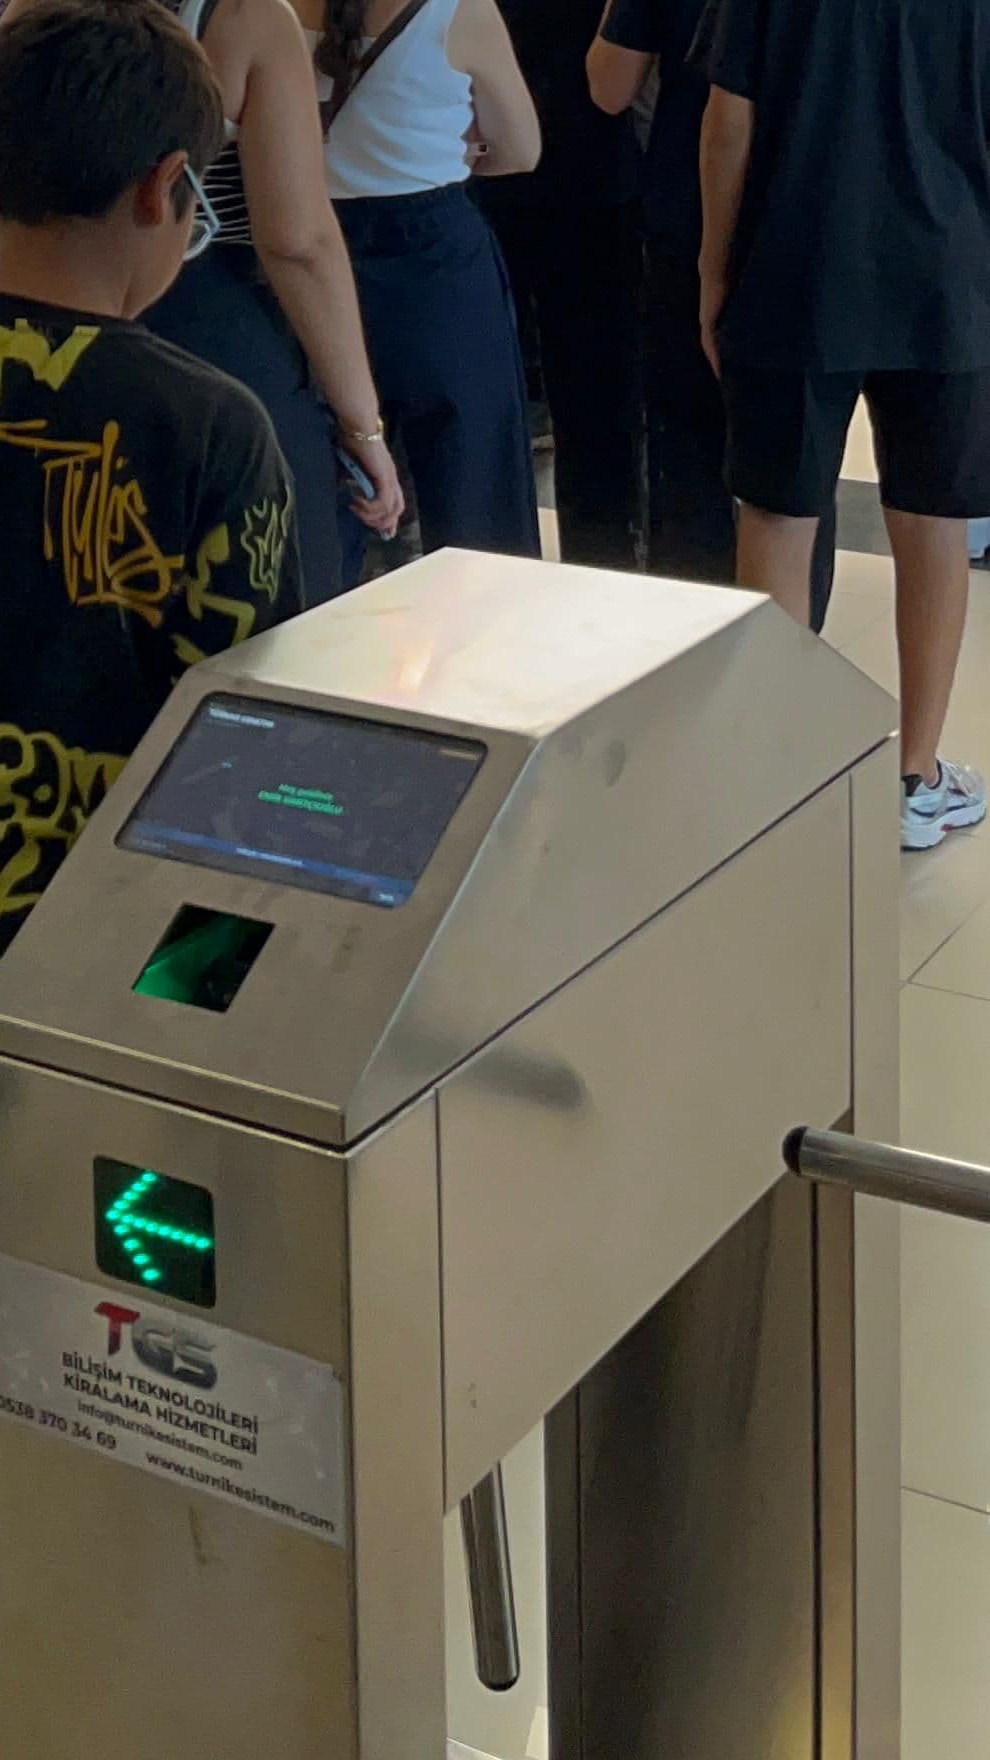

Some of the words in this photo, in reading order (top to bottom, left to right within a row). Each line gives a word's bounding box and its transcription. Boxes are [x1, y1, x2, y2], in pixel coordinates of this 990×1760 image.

[94, 1301, 218, 1390] TGS
[62, 1351, 122, 1385] BİLİŞİM
[126, 1375, 259, 1434] TEKNOLOJİLERİ
[63, 1372, 151, 1417] KİRALAMA
[156, 1404, 258, 1455] HİZMETLERİ
[146, 1451, 335, 1533] www.turnikesistem.com
